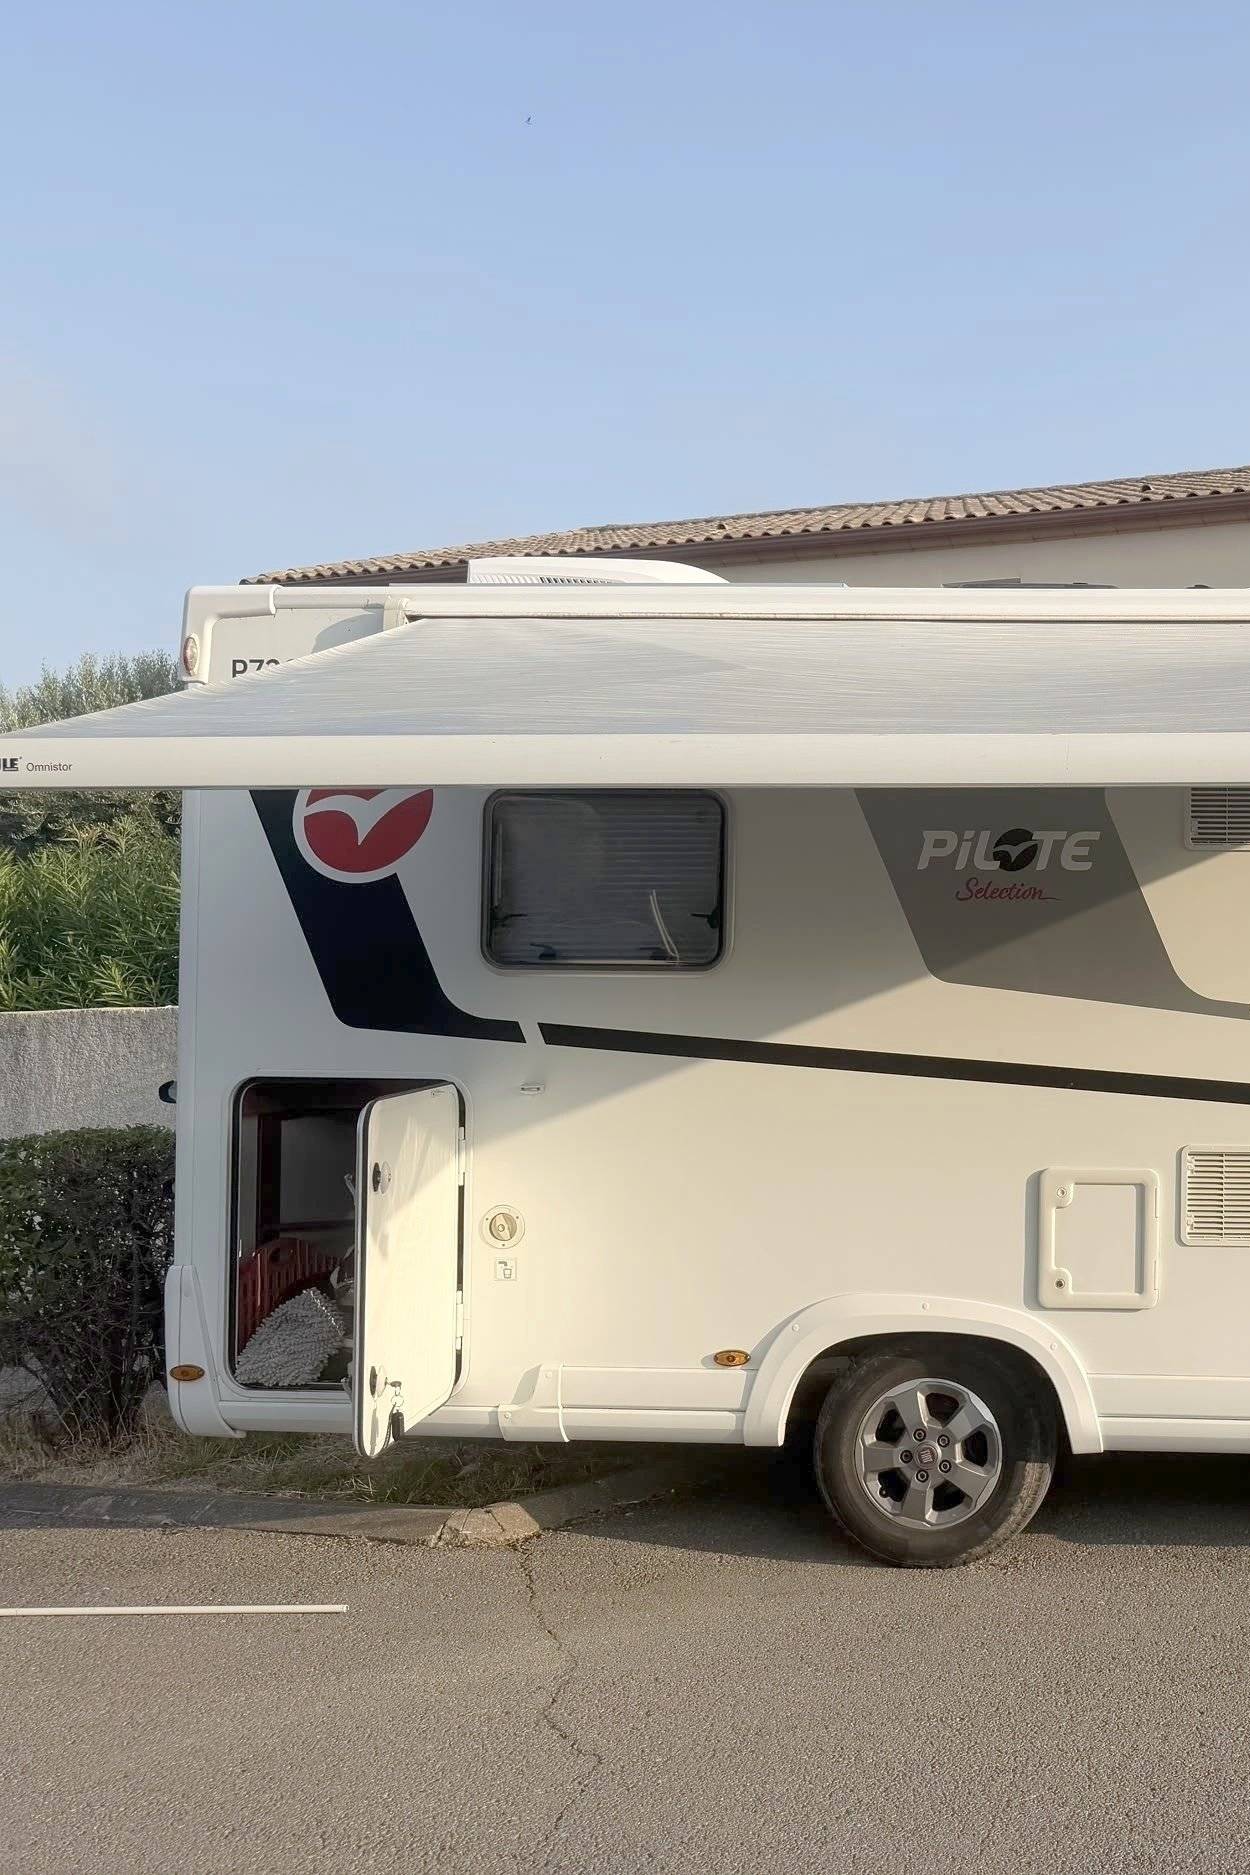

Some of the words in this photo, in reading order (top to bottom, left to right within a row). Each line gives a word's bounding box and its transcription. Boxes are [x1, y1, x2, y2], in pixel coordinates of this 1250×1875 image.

[0, 758, 19, 772] LE
[26, 762, 73, 772] Omnistor
[956, 877, 1064, 902] Selection
